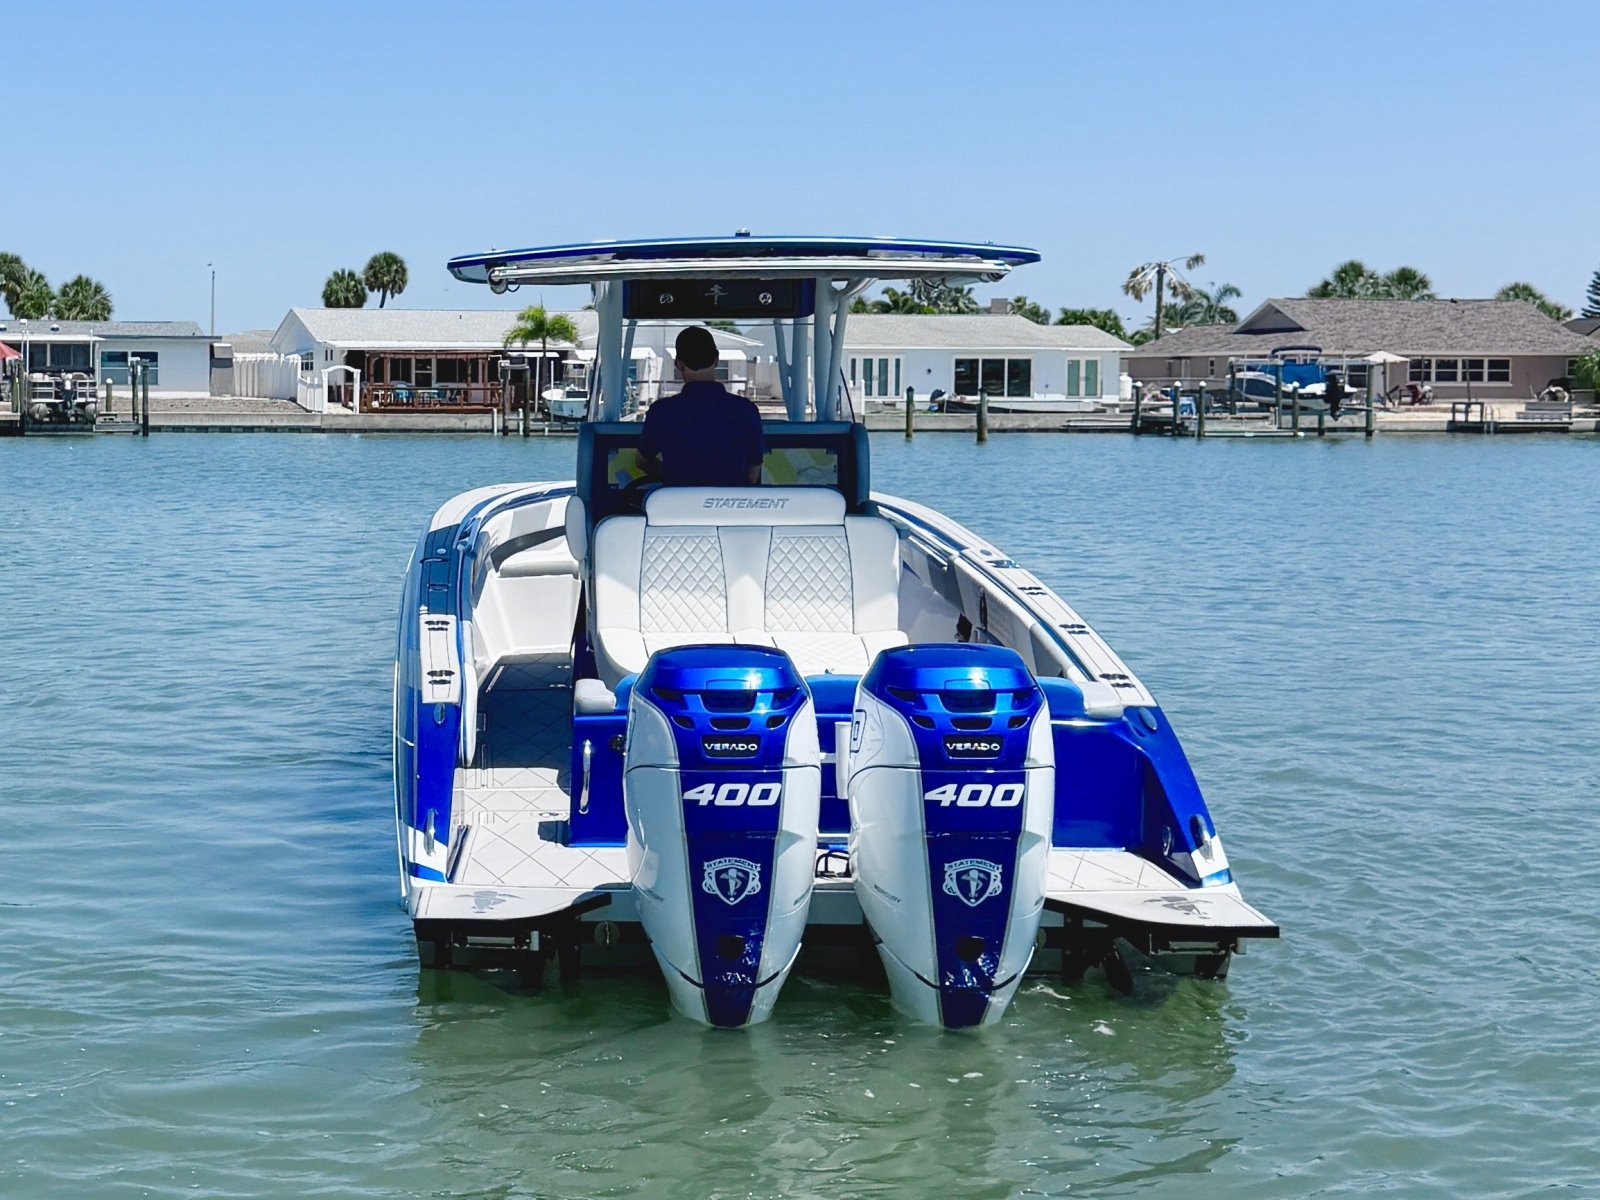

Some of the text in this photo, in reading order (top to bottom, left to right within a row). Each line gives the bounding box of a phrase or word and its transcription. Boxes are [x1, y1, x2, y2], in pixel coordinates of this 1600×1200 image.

[703, 498, 789, 509] STATEMENT
[704, 743, 759, 751] VERADO
[946, 743, 1000, 751] VERADO
[683, 783, 782, 806] 400
[924, 783, 1025, 807] 400
[705, 858, 760, 870] STATEMENT
[946, 859, 1001, 871] STATEMENT
